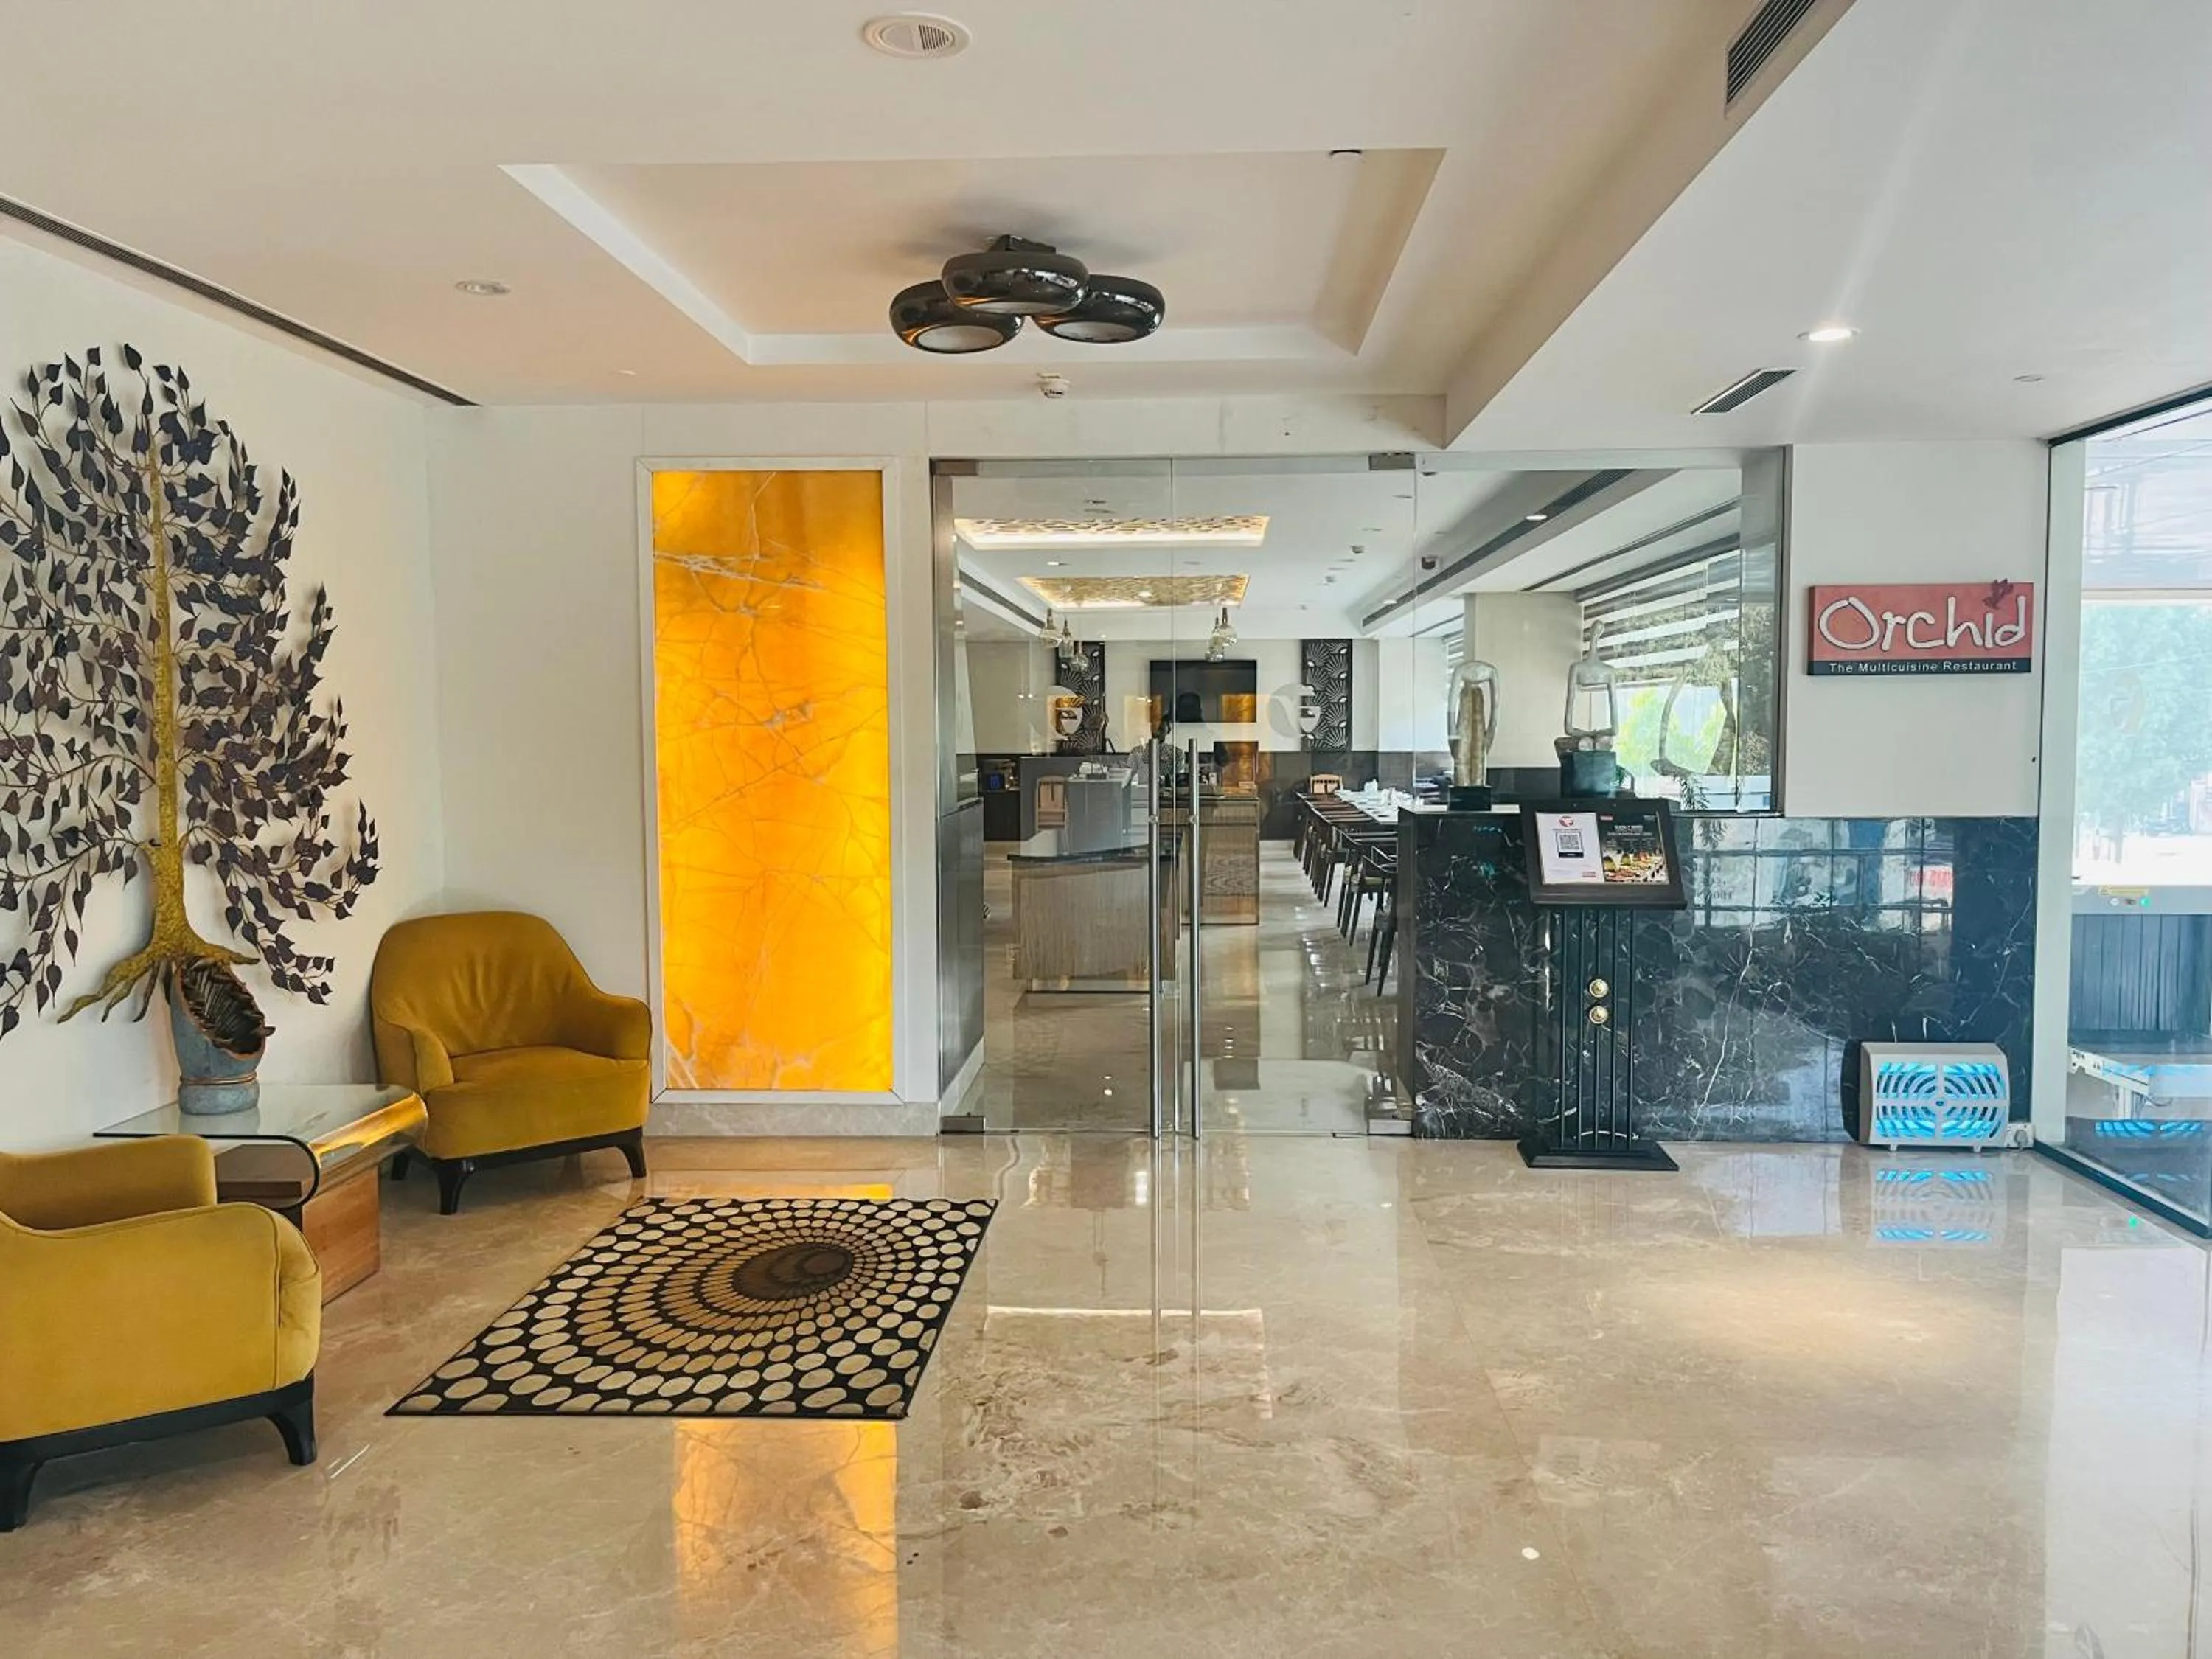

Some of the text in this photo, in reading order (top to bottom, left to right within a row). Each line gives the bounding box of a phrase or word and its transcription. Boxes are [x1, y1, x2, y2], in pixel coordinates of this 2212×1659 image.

[1818, 595, 2026, 650] Orchid
[1829, 661, 2017, 673] The Multicuisine Restaurant
